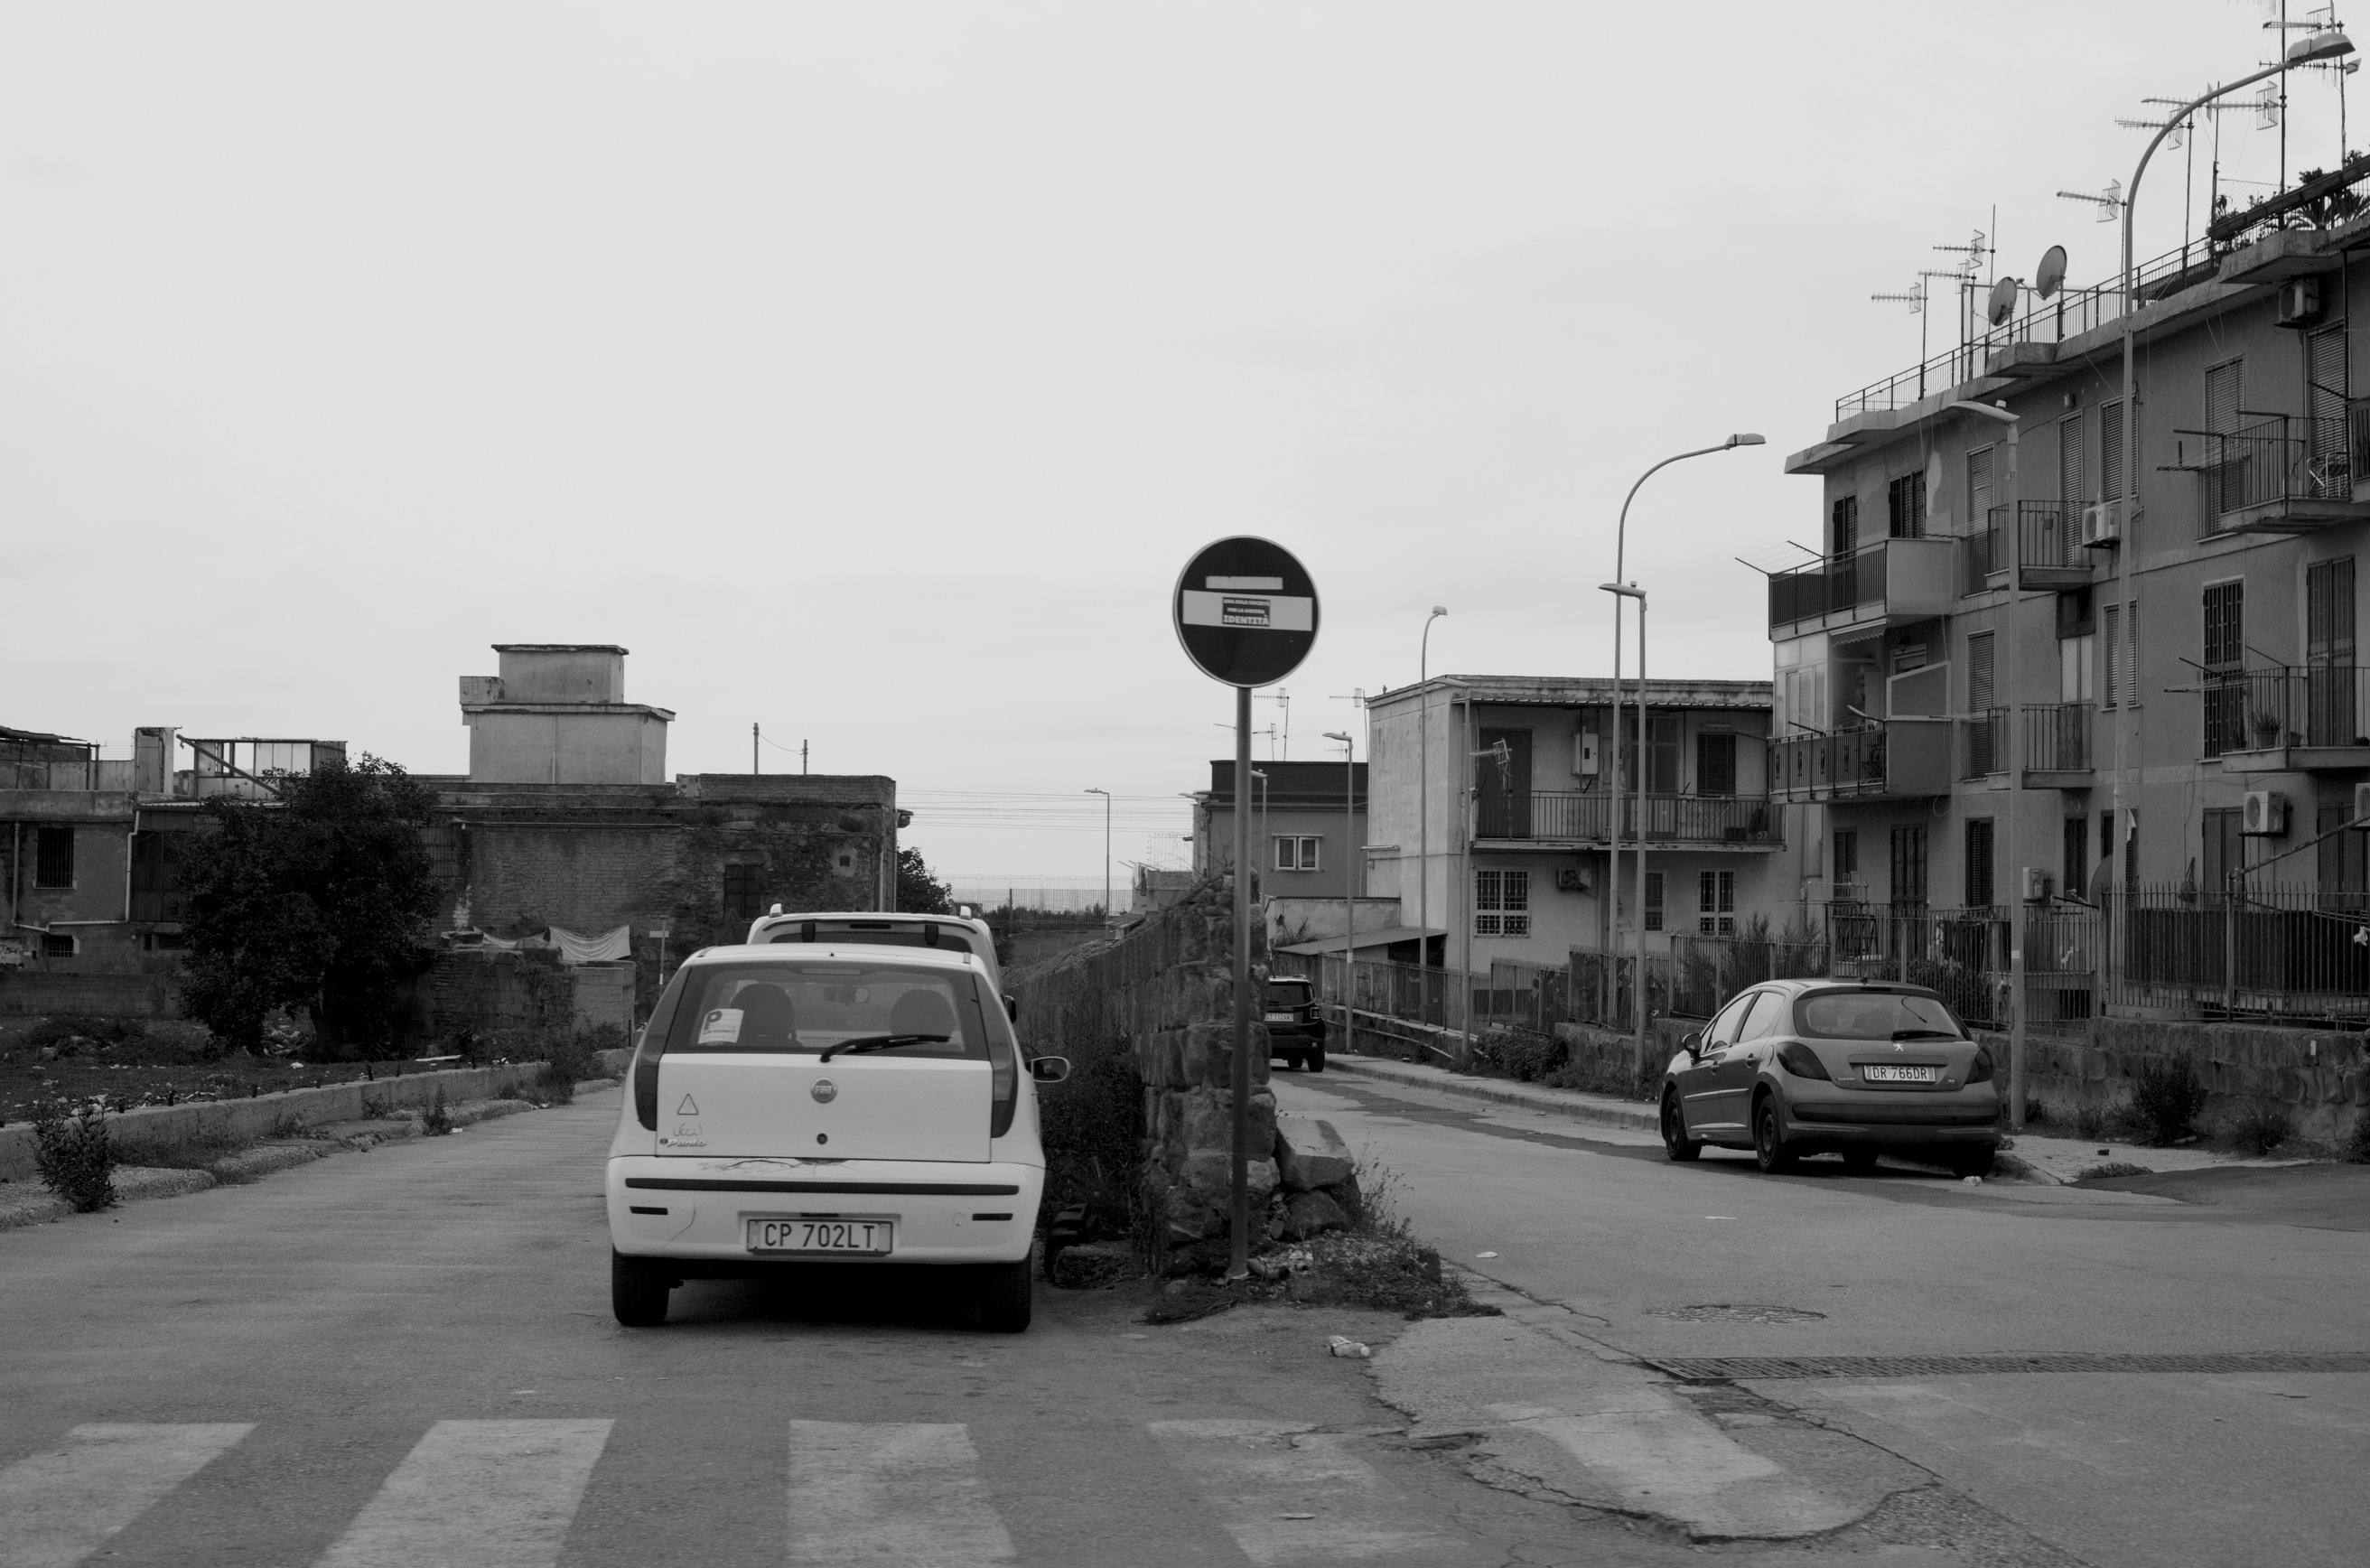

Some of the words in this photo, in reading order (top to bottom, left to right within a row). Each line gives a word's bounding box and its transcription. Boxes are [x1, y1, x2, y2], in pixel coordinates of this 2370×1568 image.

[1223, 614, 1270, 626] IDENTITÀ
[704, 1010, 723, 1031] P
[1872, 1067, 1888, 1078] DR
[1890, 1067, 1927, 1080] 766DR
[815, 1085, 833, 1094] FIAT
[667, 1139, 707, 1148] Punto
[765, 1223, 792, 1246] CP
[802, 1224, 875, 1249] 702LT
